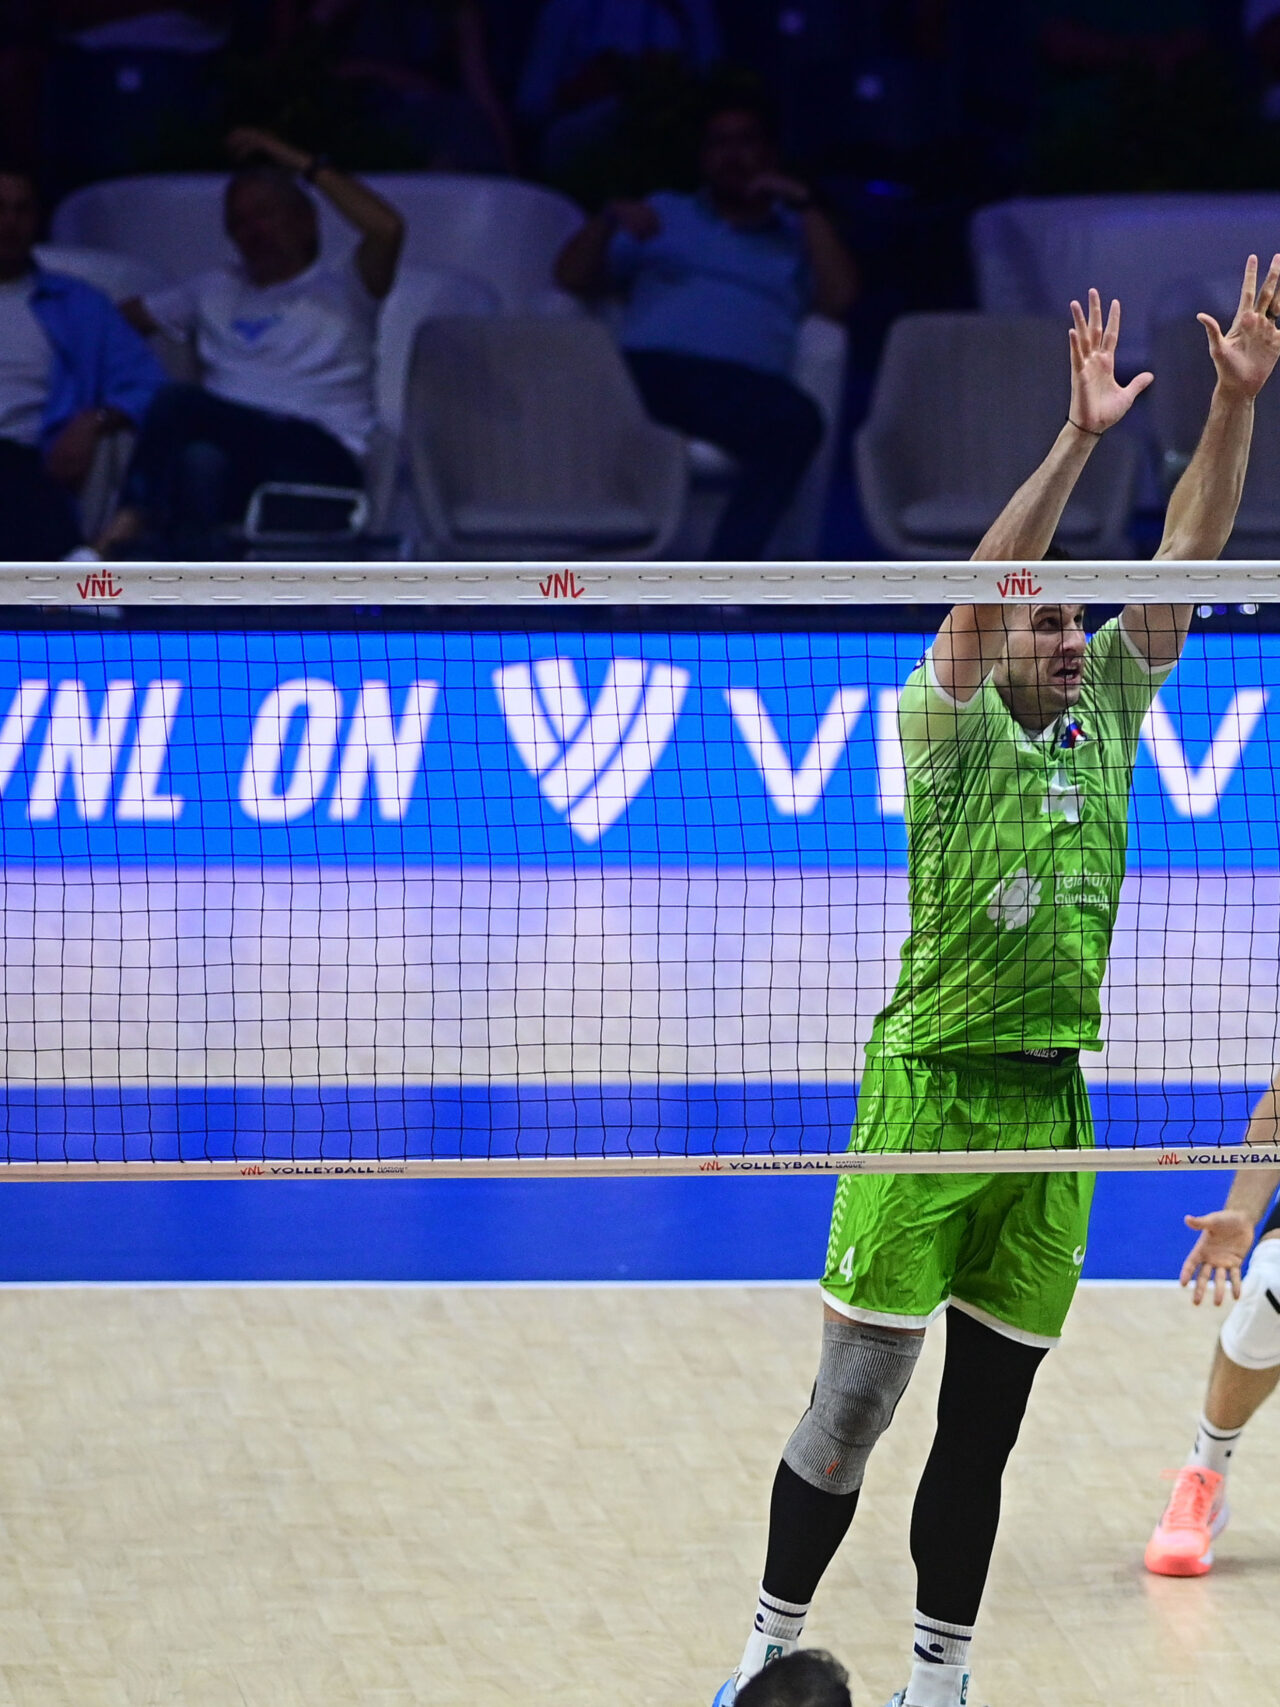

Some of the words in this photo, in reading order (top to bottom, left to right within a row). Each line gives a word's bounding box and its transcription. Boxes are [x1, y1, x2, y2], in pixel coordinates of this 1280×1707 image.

[76, 569, 123, 600] VNL
[538, 569, 585, 599] VNL
[996, 568, 1042, 598] VNL
[238, 677, 440, 823] ON
[240, 1165, 265, 1176] VNL
[699, 1160, 724, 1171] VNL
[729, 1161, 832, 1170] VOLLEYBALL
[1157, 1152, 1182, 1165] VNL
[839, 1245, 855, 1282] 4
